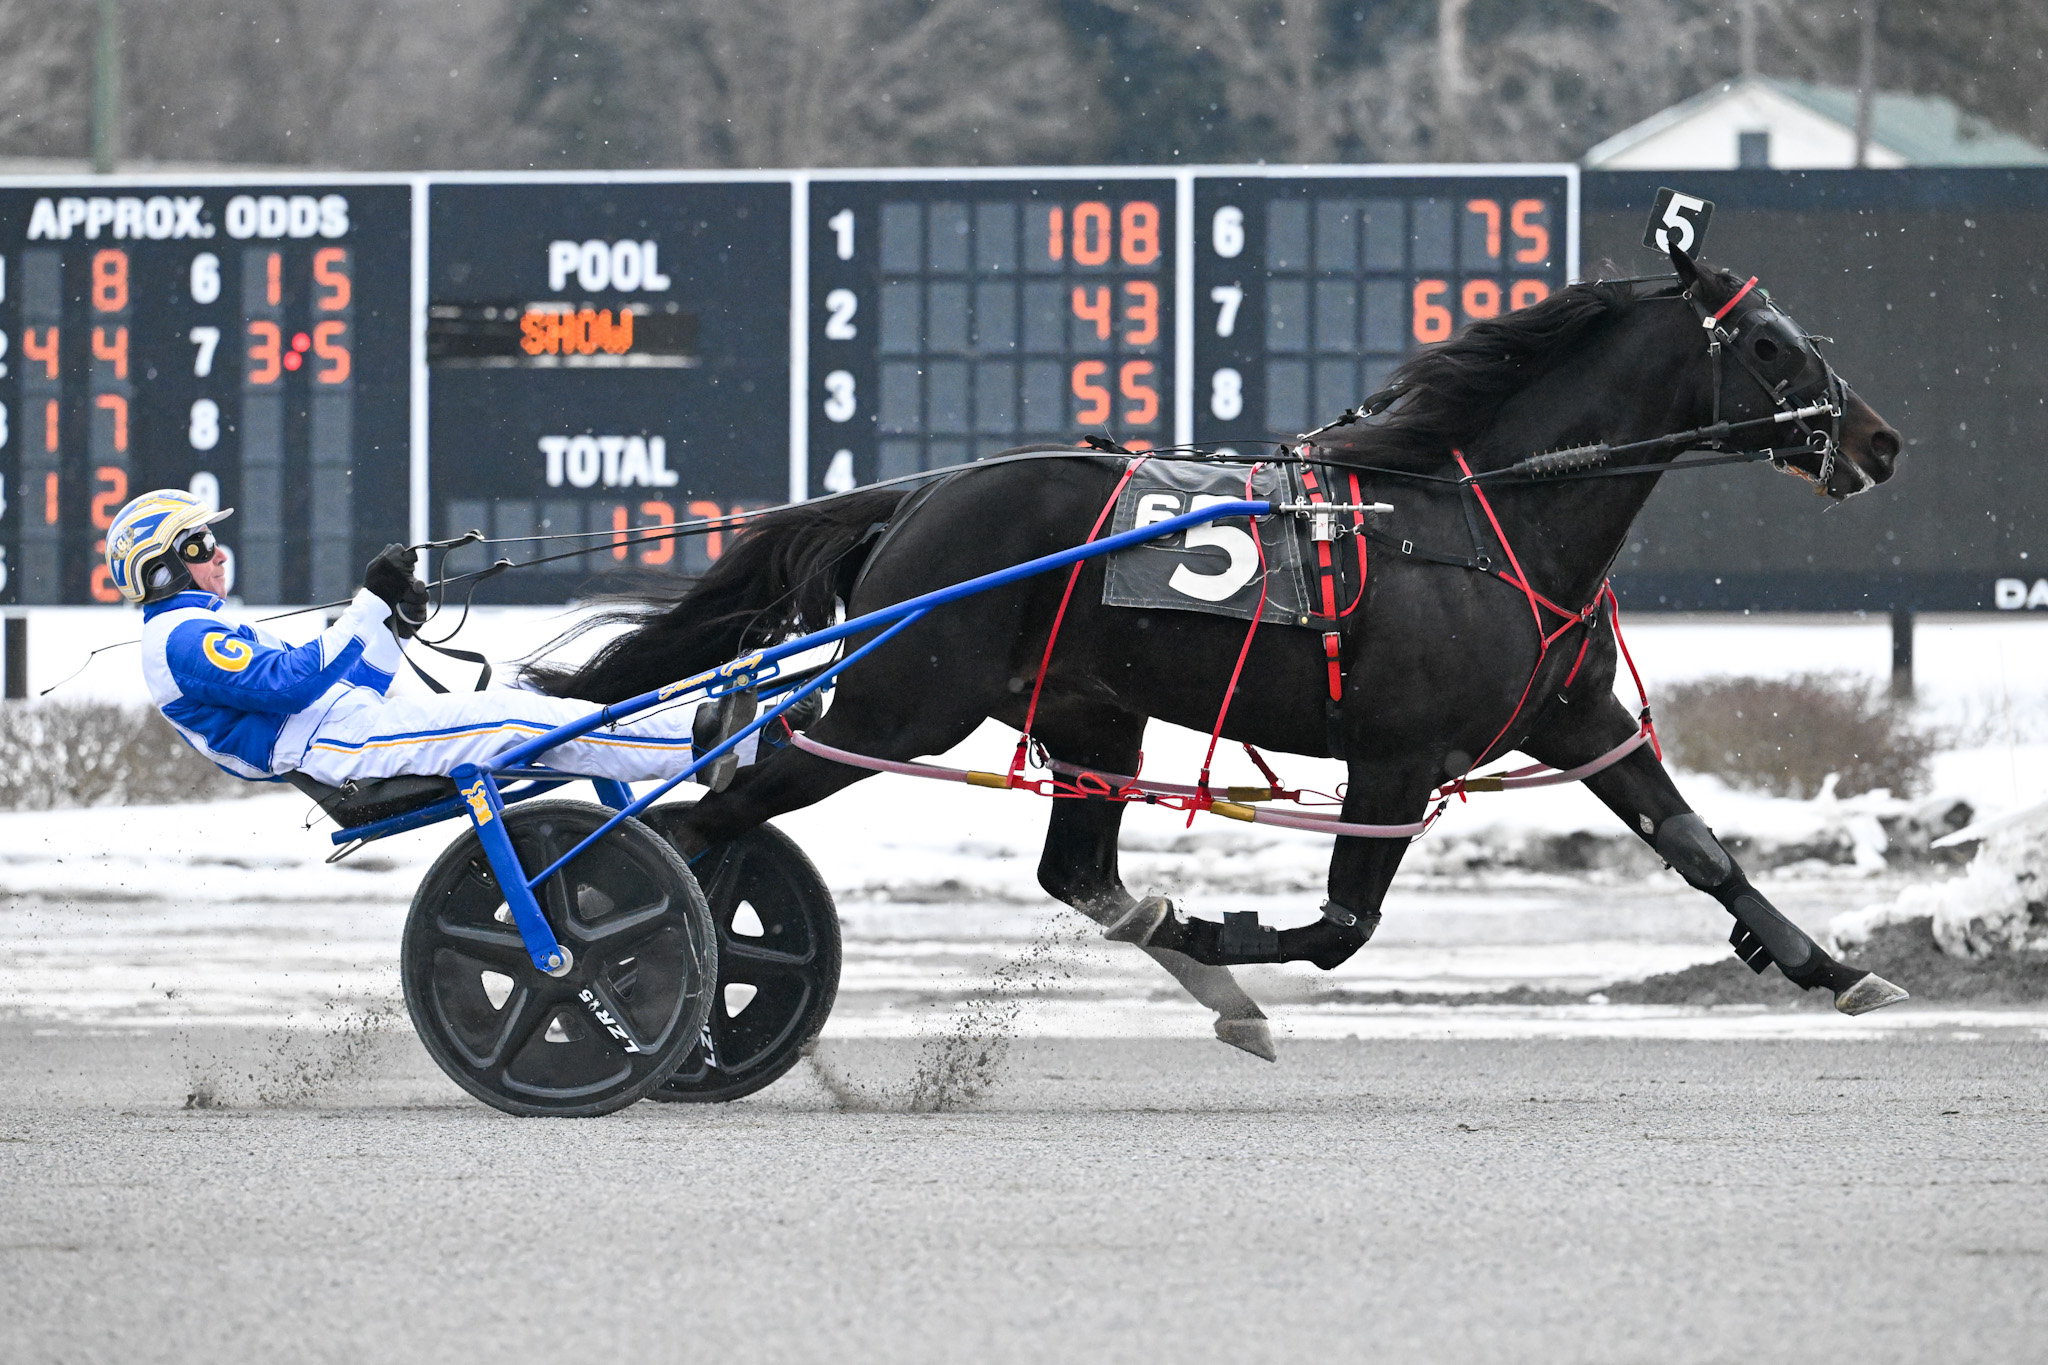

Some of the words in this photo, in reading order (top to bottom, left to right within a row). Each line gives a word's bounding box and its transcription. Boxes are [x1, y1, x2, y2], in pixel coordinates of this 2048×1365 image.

[27, 196, 216, 240] APPROX.
[225, 195, 349, 239] ODDS
[828, 209, 854, 260] 1
[1049, 201, 1159, 265] 108
[1212, 206, 1245, 258] 6
[1468, 199, 1550, 263] 75
[1656, 193, 1704, 254] 5
[92, 250, 128, 312] 8
[190, 253, 220, 303] 6
[549, 240, 671, 292] POOL
[520, 309, 634, 355] SHOW
[826, 289, 857, 340] 2
[1072, 281, 1159, 345] 43
[1211, 285, 1243, 337] 7
[190, 326, 220, 377] 7
[824, 371, 857, 422] 3
[1071, 360, 1159, 425] 55
[1211, 368, 1243, 421] 8
[189, 399, 220, 450] 8
[538, 436, 679, 488] TOTAL
[823, 450, 857, 493] 4
[1167, 495, 1262, 602] 5
[1995, 578, 2048, 610] DA
[203, 632, 253, 672] G
[595, 1009, 640, 1054] LZR
